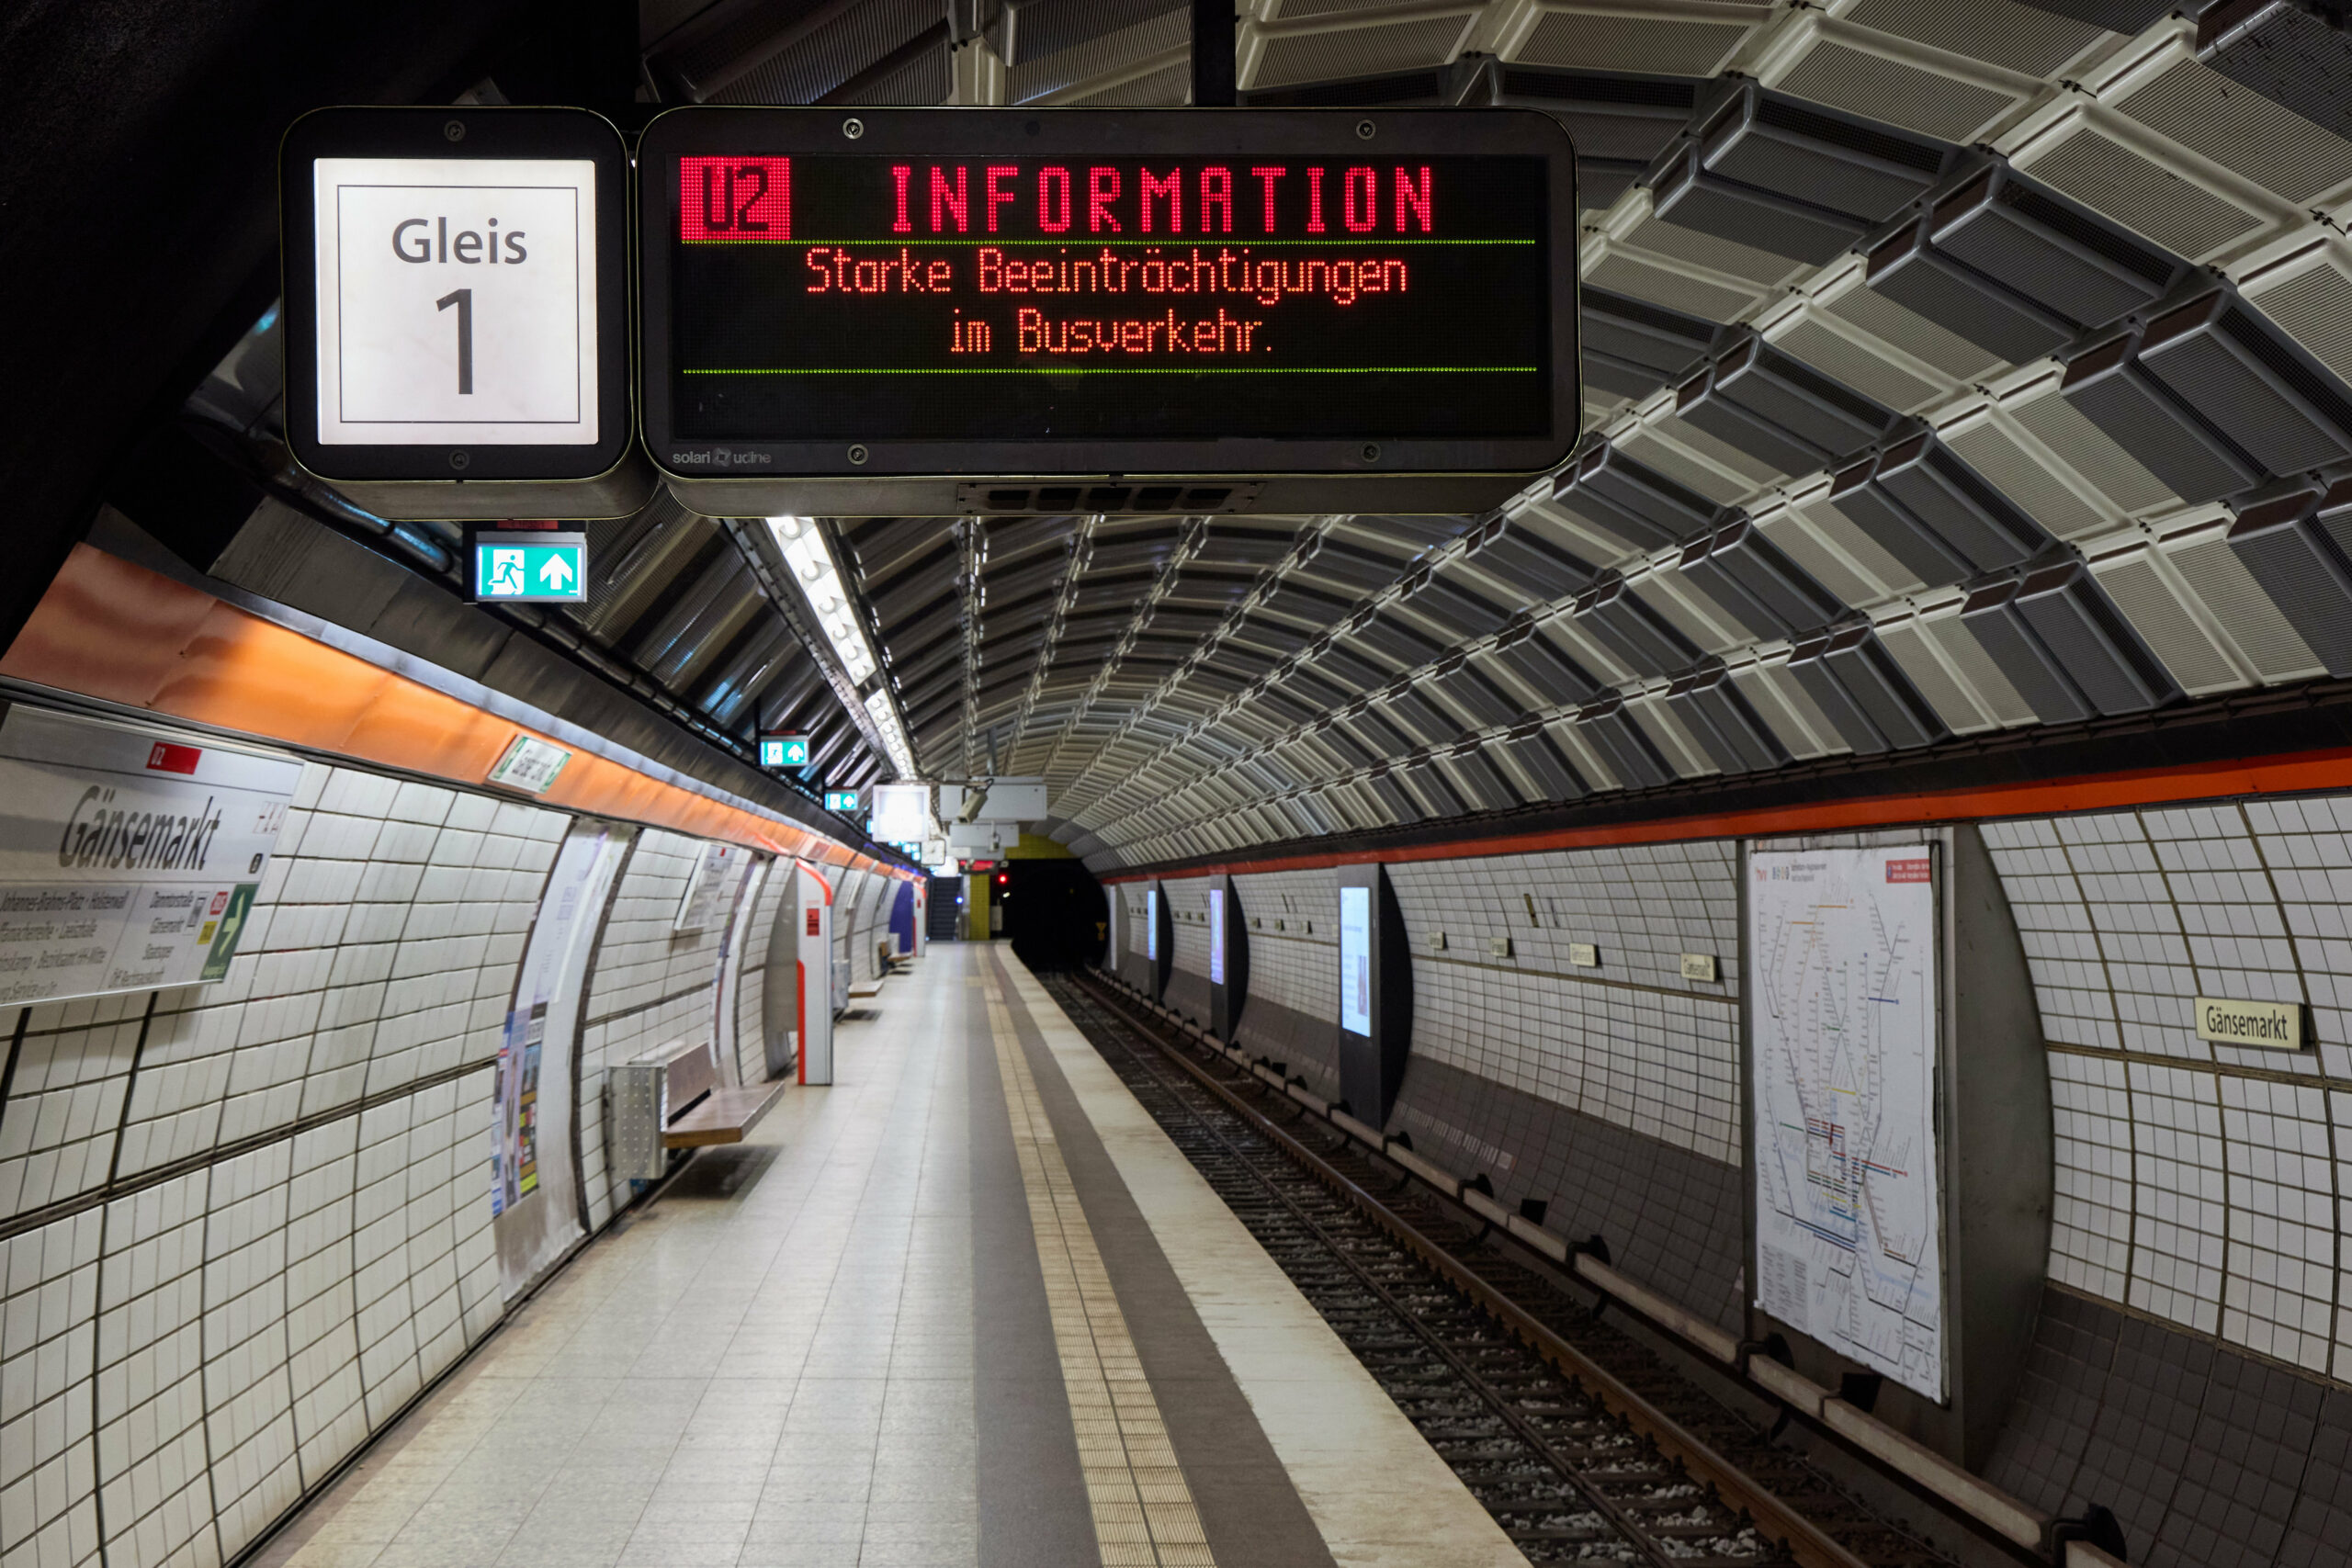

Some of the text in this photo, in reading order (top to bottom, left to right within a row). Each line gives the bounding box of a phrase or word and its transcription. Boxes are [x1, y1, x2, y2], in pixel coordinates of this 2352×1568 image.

[702, 165, 1431, 232] U2 INFORMATION
[393, 217, 526, 264] Gleis
[807, 248, 1407, 305] Starke Beeinträchtigungen
[436, 289, 472, 394] 1
[951, 309, 1271, 354] im Busverkehr.
[673, 451, 710, 464] solari
[59, 784, 221, 871] Gänsemarkt
[2206, 1005, 2289, 1041] Gänsemarkt
